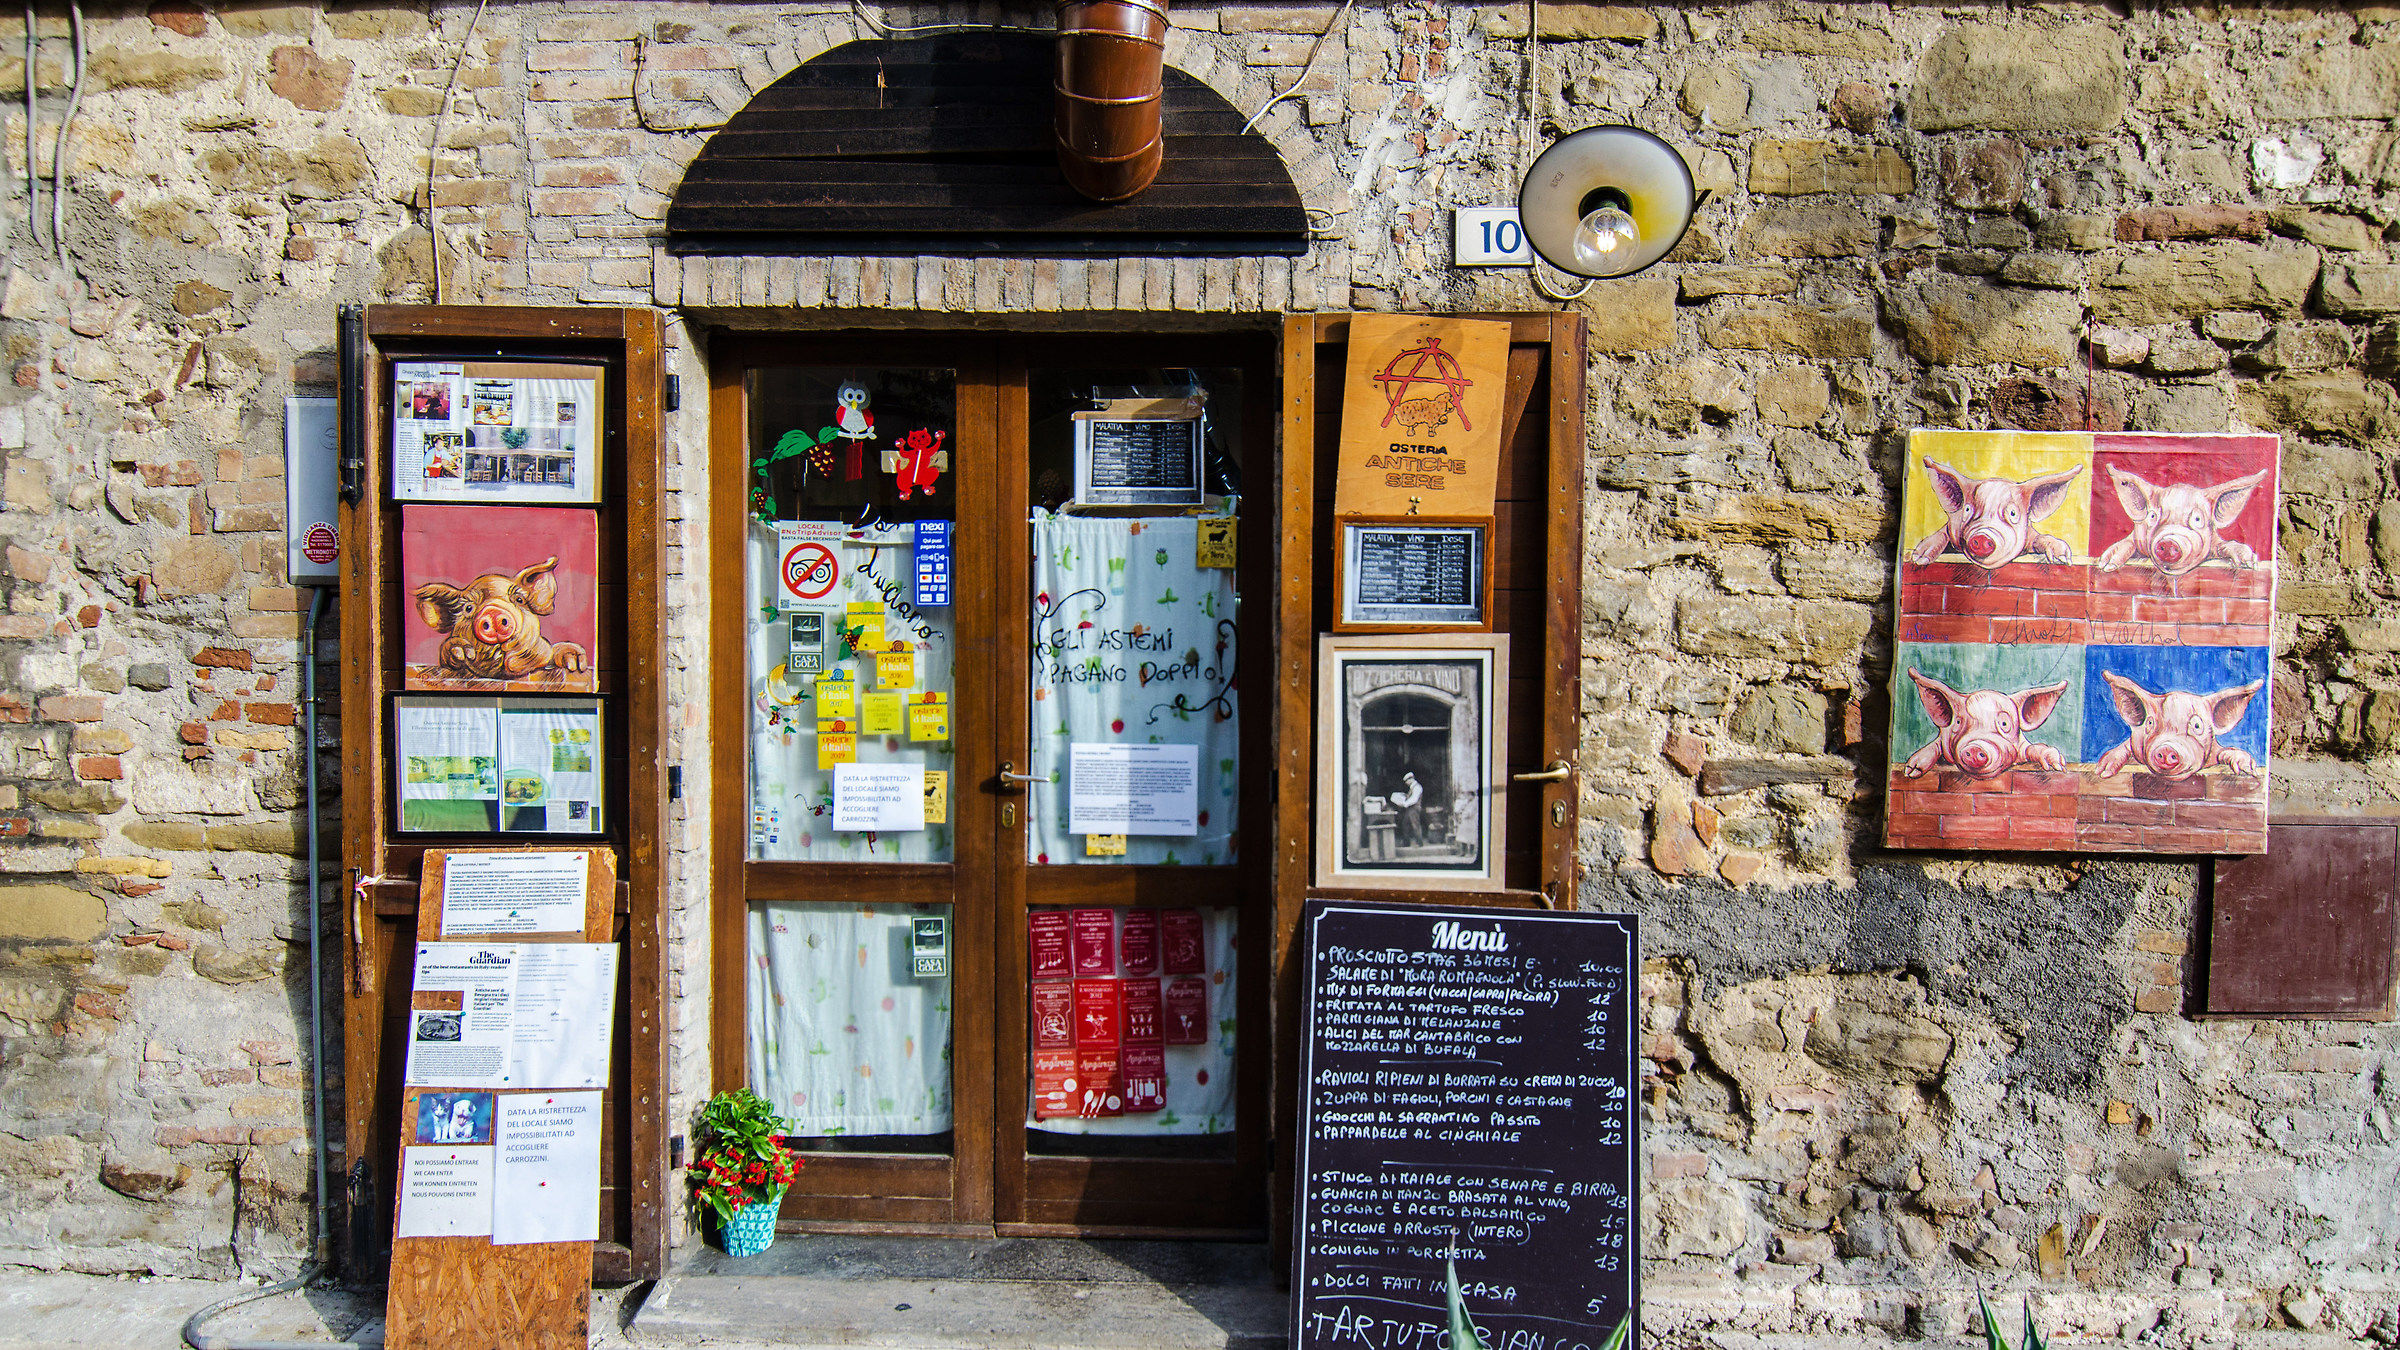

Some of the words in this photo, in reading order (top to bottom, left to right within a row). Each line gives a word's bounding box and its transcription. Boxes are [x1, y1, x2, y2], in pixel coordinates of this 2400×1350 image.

[1480, 219, 1521, 254] 10
[1389, 443, 1448, 456] OSTERIA
[1365, 455, 1467, 475] ANTICHE
[1385, 473, 1446, 491] SERE
[781, 529, 842, 537] #NoTripAdvisor
[920, 522, 945, 531] nexi
[1050, 628, 1086, 650] GLI
[1098, 628, 1173, 651] ASTEMI
[1049, 661, 1127, 684] PAGANO
[1353, 667, 1423, 694] PIZZICHERIA
[1434, 668, 1461, 693] VINO
[1432, 920, 1510, 952] Menù
[469, 956, 511, 965] Guardian
[478, 950, 496, 959] The
[1329, 945, 1409, 964] PROSCIUTTO
[1484, 954, 1517, 969] MESI
[1326, 964, 1378, 982] SALAME
[1381, 969, 1394, 982] DI
[1326, 982, 1347, 998] MIX
[1350, 985, 1363, 997] DI
[1588, 992, 1610, 1005] 12
[1325, 998, 1383, 1012] FRITTATA
[1387, 1001, 1405, 1012] AL
[1409, 1003, 1468, 1015] TARTUFO
[1473, 1003, 1525, 1016] FRESCO
[1586, 1009, 1608, 1022] 10
[1325, 1012, 1400, 1026] PARMIGIANA
[1403, 1015, 1416, 1027] DI
[1421, 1016, 1502, 1030] MELANZANE
[1583, 1023, 1606, 1035] 10
[1324, 1026, 1357, 1040] ALICI
[1362, 1028, 1384, 1040] DEL
[1388, 1027, 1411, 1040] MAR
[1413, 1030, 1491, 1044] CANTABRICO
[1496, 1035, 1523, 1045] CON
[1583, 1038, 1606, 1051] 12
[1325, 1040, 1401, 1053] MOZZARELLA
[1404, 1043, 1417, 1055] DI
[1424, 1044, 1477, 1060] BUFALA
[1321, 1068, 1369, 1087] RAVIOLI
[1375, 1070, 1424, 1087] RIPIENI
[1428, 1073, 1440, 1086] DI
[1444, 1072, 1496, 1087] BURRATA
[1499, 1076, 1519, 1087] SU
[1523, 1074, 1562, 1088] CREMA
[1565, 1076, 1576, 1088] DI
[1578, 1074, 1616, 1088] ZUCCA
[1605, 1085, 1627, 1099] 10
[507, 1108, 527, 1116] DATA
[528, 1108, 537, 1116] LA
[538, 1106, 587, 1115] RISTRETTEZZA
[1323, 1091, 1369, 1105] ZUPPA
[1373, 1091, 1387, 1104] DI
[1392, 1092, 1443, 1108] FAGIOLI,
[1445, 1090, 1490, 1104] PORCINI
[1495, 1094, 1505, 1105] E
[1507, 1095, 1573, 1107] CASTAGNE
[1600, 1101, 1623, 1112] 10
[506, 1120, 520, 1128] DEL
[521, 1120, 548, 1128] LOCALE
[549, 1118, 574, 1126] SIAMO
[1321, 1110, 1375, 1124] GNOCCHI
[1378, 1111, 1394, 1124] AL
[1397, 1111, 1480, 1125] SAGRANTINO
[1490, 1111, 1541, 1126] PASSITO
[1600, 1116, 1622, 1128] 10
[506, 1130, 563, 1140] IMPOSSIBILITATI
[506, 1142, 549, 1151] ACCOGLIERE
[1323, 1124, 1408, 1140] PAPPARDELLE
[1413, 1128, 1432, 1140] AL
[1438, 1129, 1522, 1143] CINGHIALE
[1599, 1131, 1623, 1146] 12
[1321, 1170, 1373, 1184] STINCO
[1380, 1172, 1396, 1185] DI
[1400, 1172, 1452, 1186] MAIALE
[1457, 1176, 1484, 1188] CON
[1488, 1177, 1548, 1192] SENAPE
[1553, 1182, 1565, 1195] E
[1570, 1181, 1618, 1197] BIRRA
[1606, 1194, 1628, 1209] 13
[1321, 1187, 1378, 1200] GUANCIA
[1382, 1189, 1393, 1200] DI
[1397, 1189, 1441, 1201] MANZO
[1448, 1189, 1508, 1204] BRASATA
[1514, 1195, 1534, 1206] AL
[1538, 1196, 1571, 1214] VINO,
[1321, 1202, 1385, 1216] COGNAC
[1392, 1201, 1402, 1214] E
[1408, 1202, 1455, 1217] ACETO
[1461, 1205, 1546, 1222] BALSAMICO
[1600, 1213, 1627, 1229] 15
[1321, 1218, 1387, 1234] PICCIONE
[1393, 1221, 1461, 1236] ARROSTO
[1467, 1220, 1532, 1246] (INTERO)
[1596, 1231, 1623, 1248] 18
[1319, 1243, 1380, 1256] CONIGLIO
[1386, 1246, 1400, 1255] IN
[1407, 1245, 1487, 1261] PORCHETTA
[1594, 1253, 1619, 1272] 13
[1324, 1272, 1370, 1289] DOLCI
[1382, 1275, 1422, 1292] FATTI
[1429, 1279, 1448, 1294] IN
[1460, 1281, 1518, 1301] CASA
